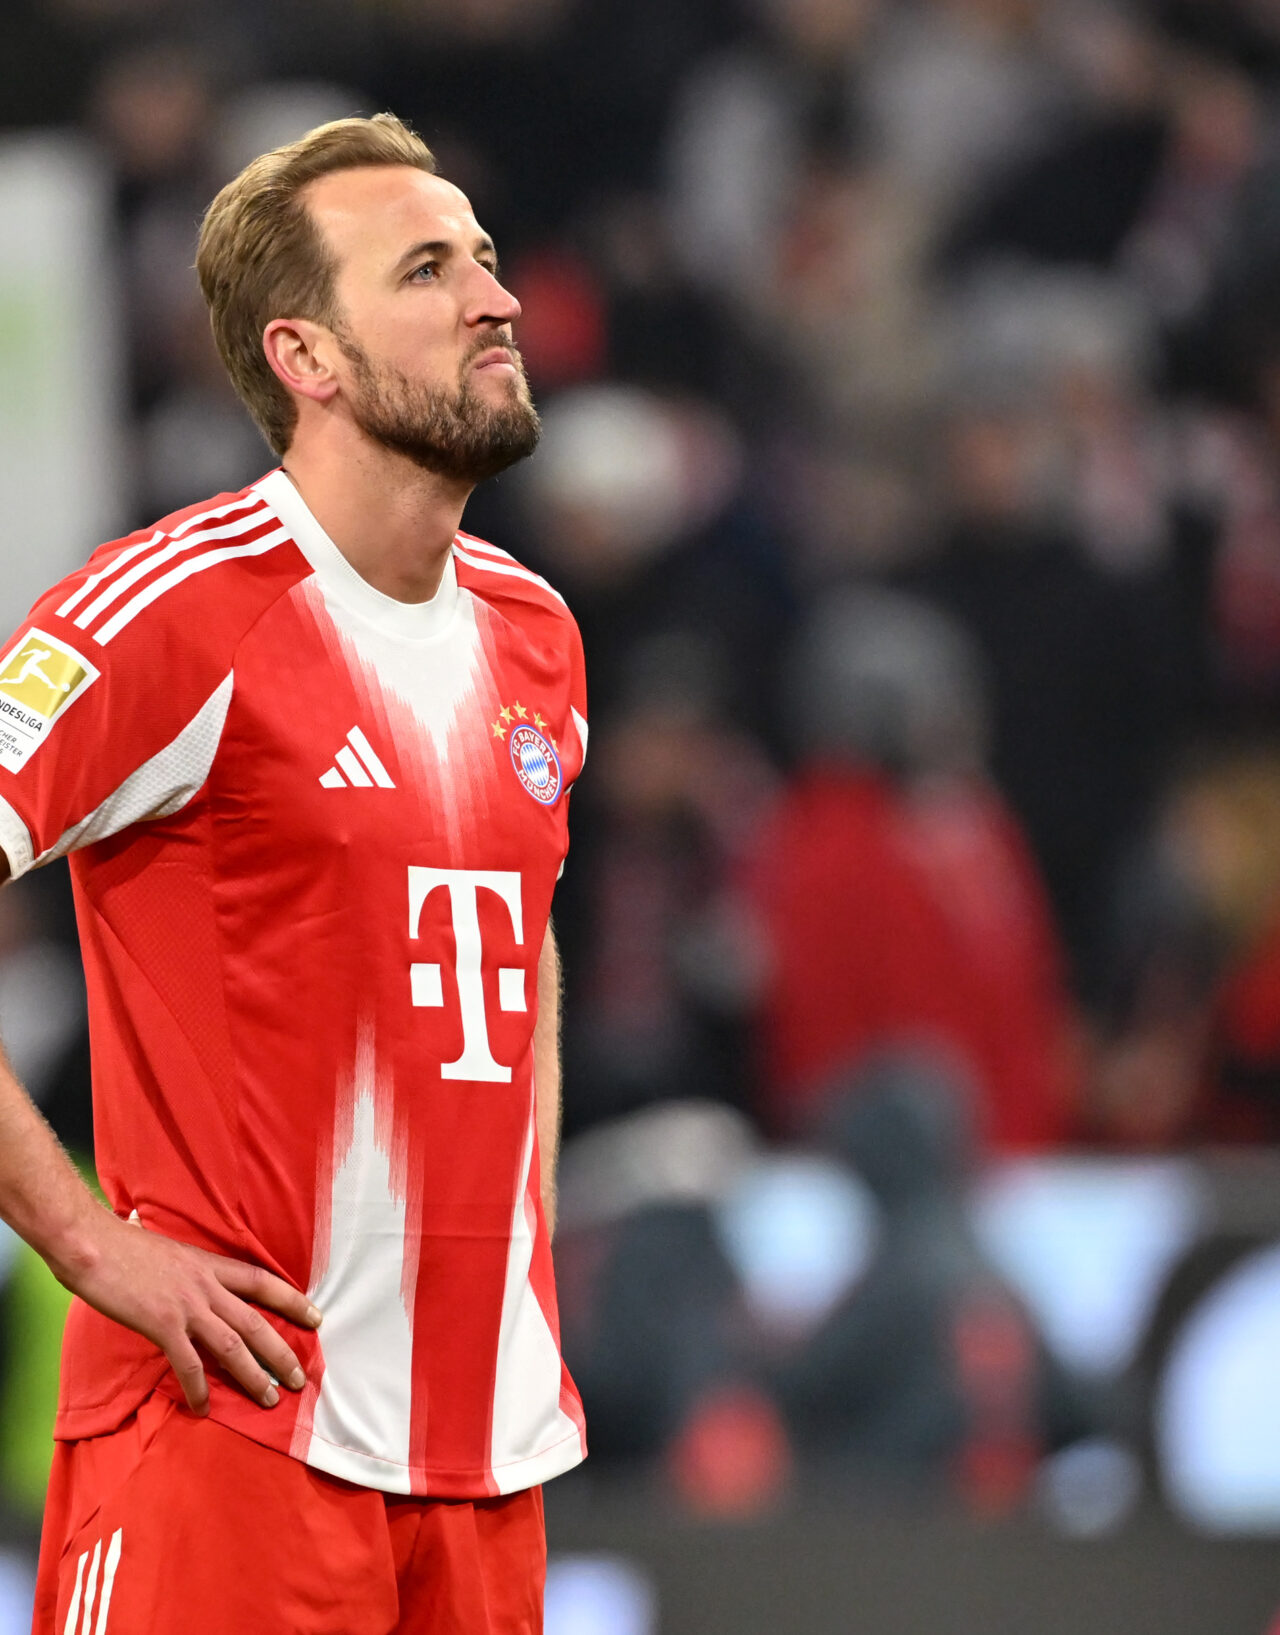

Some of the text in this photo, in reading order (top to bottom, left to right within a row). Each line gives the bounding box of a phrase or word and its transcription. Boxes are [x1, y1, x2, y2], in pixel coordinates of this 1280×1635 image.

[513, 732, 553, 762] FC BAYERN
[408, 866, 526, 1082] T
